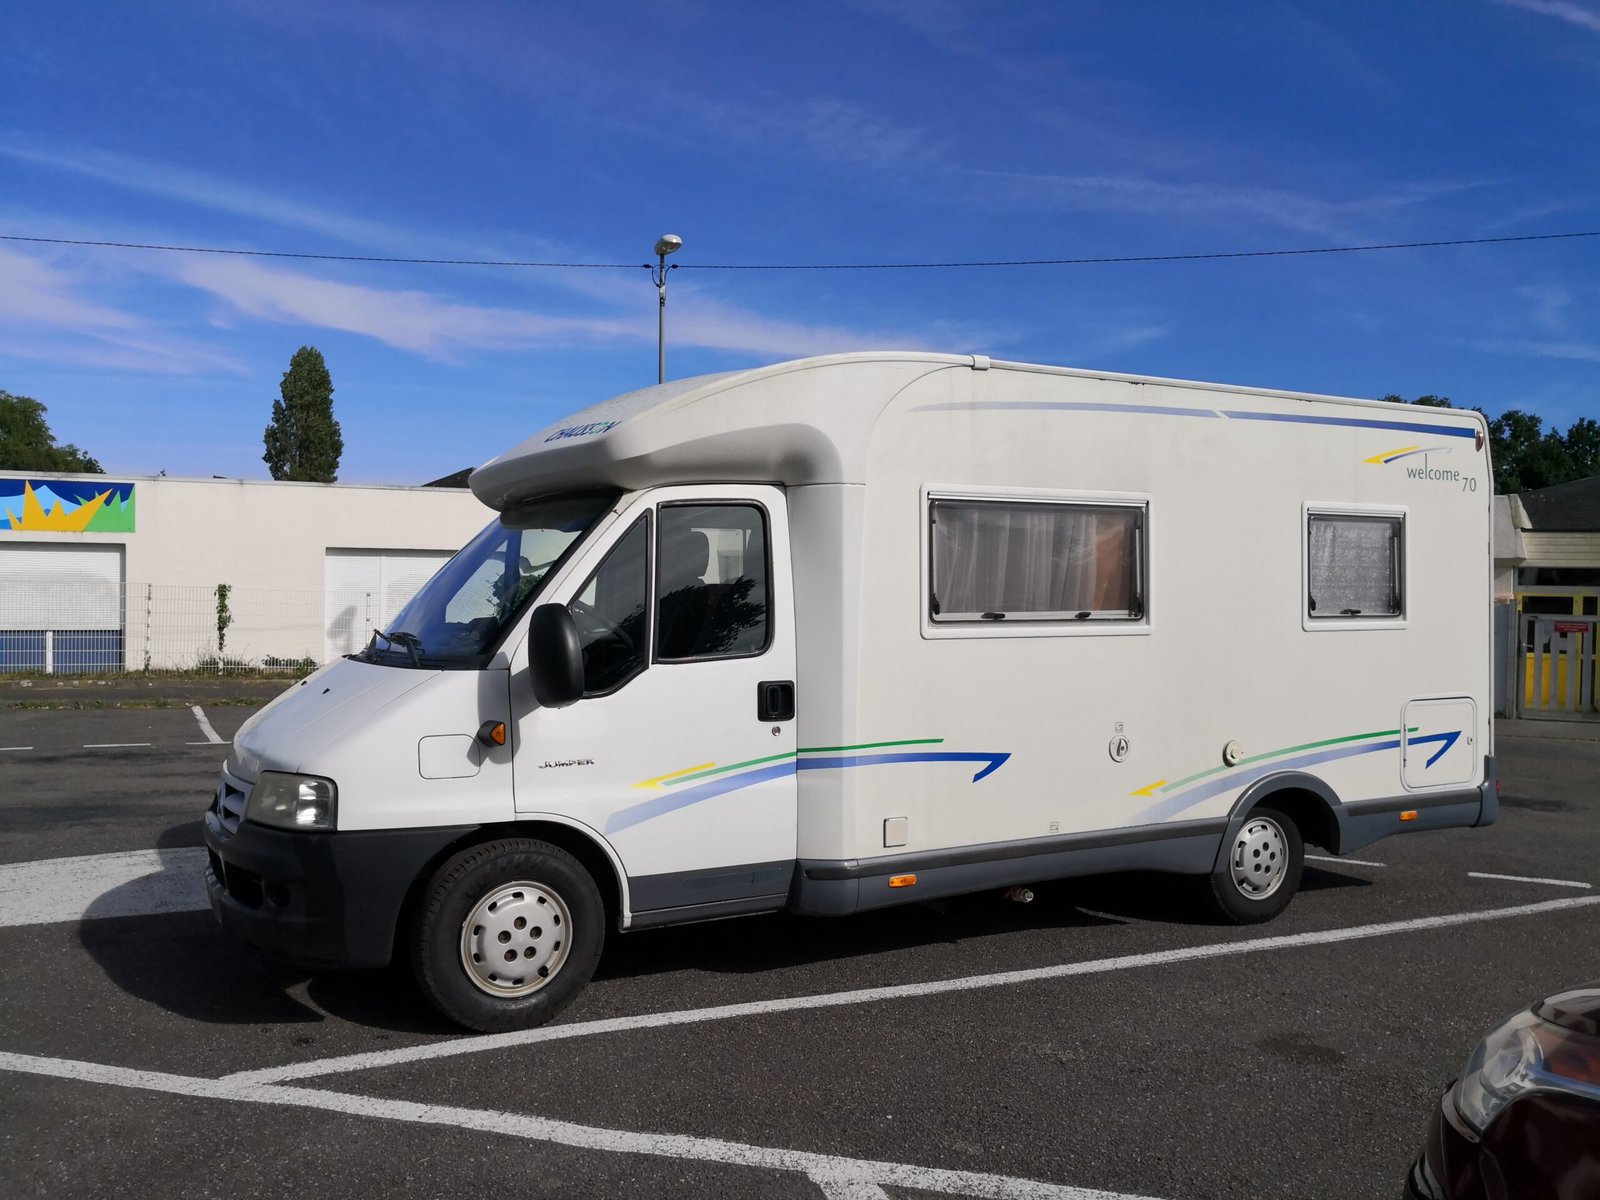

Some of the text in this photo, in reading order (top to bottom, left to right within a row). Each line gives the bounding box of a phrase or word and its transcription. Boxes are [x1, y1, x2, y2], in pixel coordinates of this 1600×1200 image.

[1406, 453, 1477, 492] welcome 70
[538, 759, 595, 769] JUMPER
